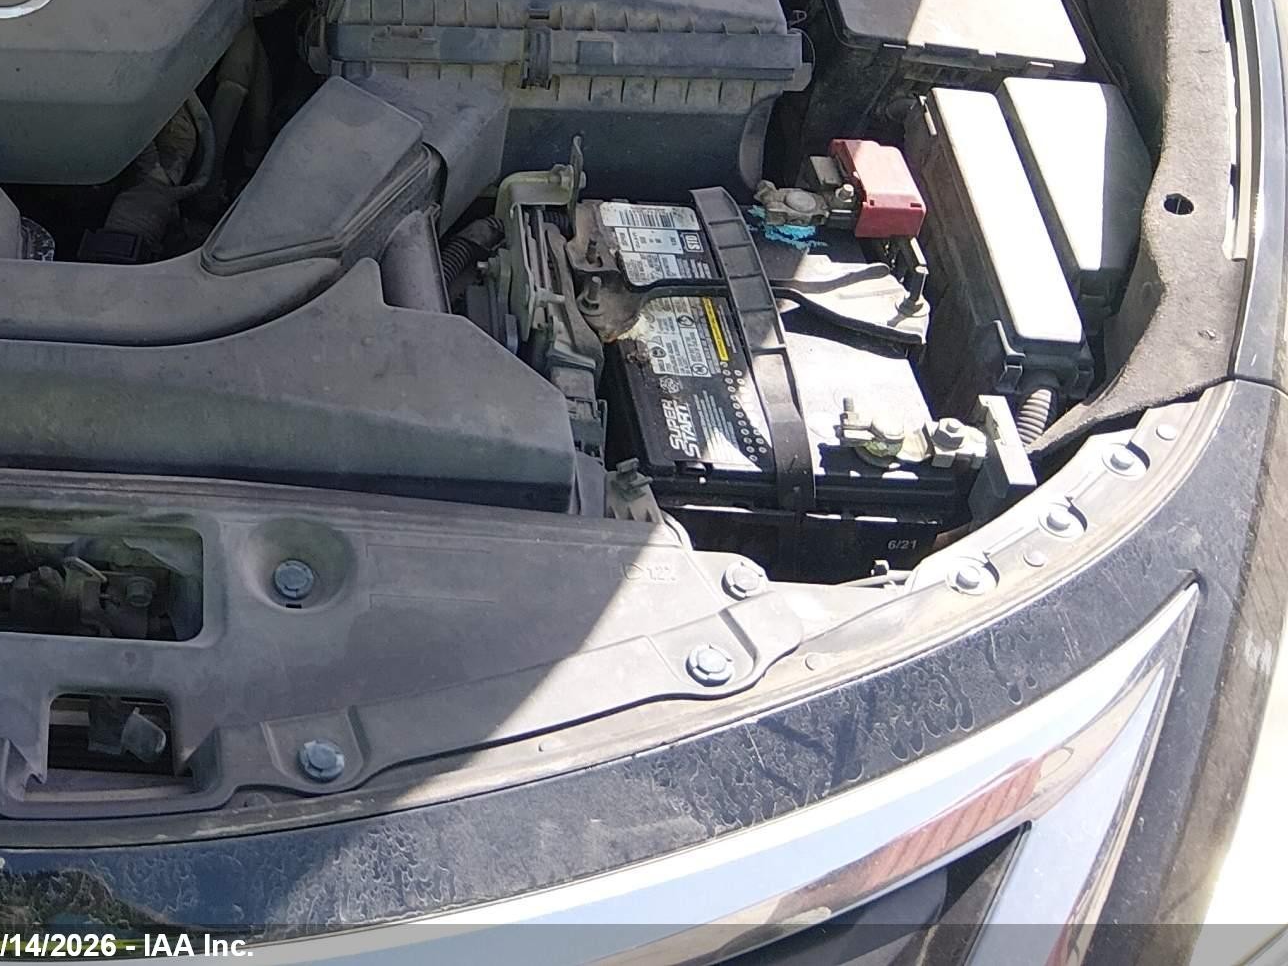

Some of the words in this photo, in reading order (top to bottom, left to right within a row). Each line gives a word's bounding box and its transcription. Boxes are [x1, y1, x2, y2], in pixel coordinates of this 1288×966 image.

[661, 398, 682, 450] SUPER
[675, 400, 702, 458] START
[887, 539, 917, 550] 6/21
